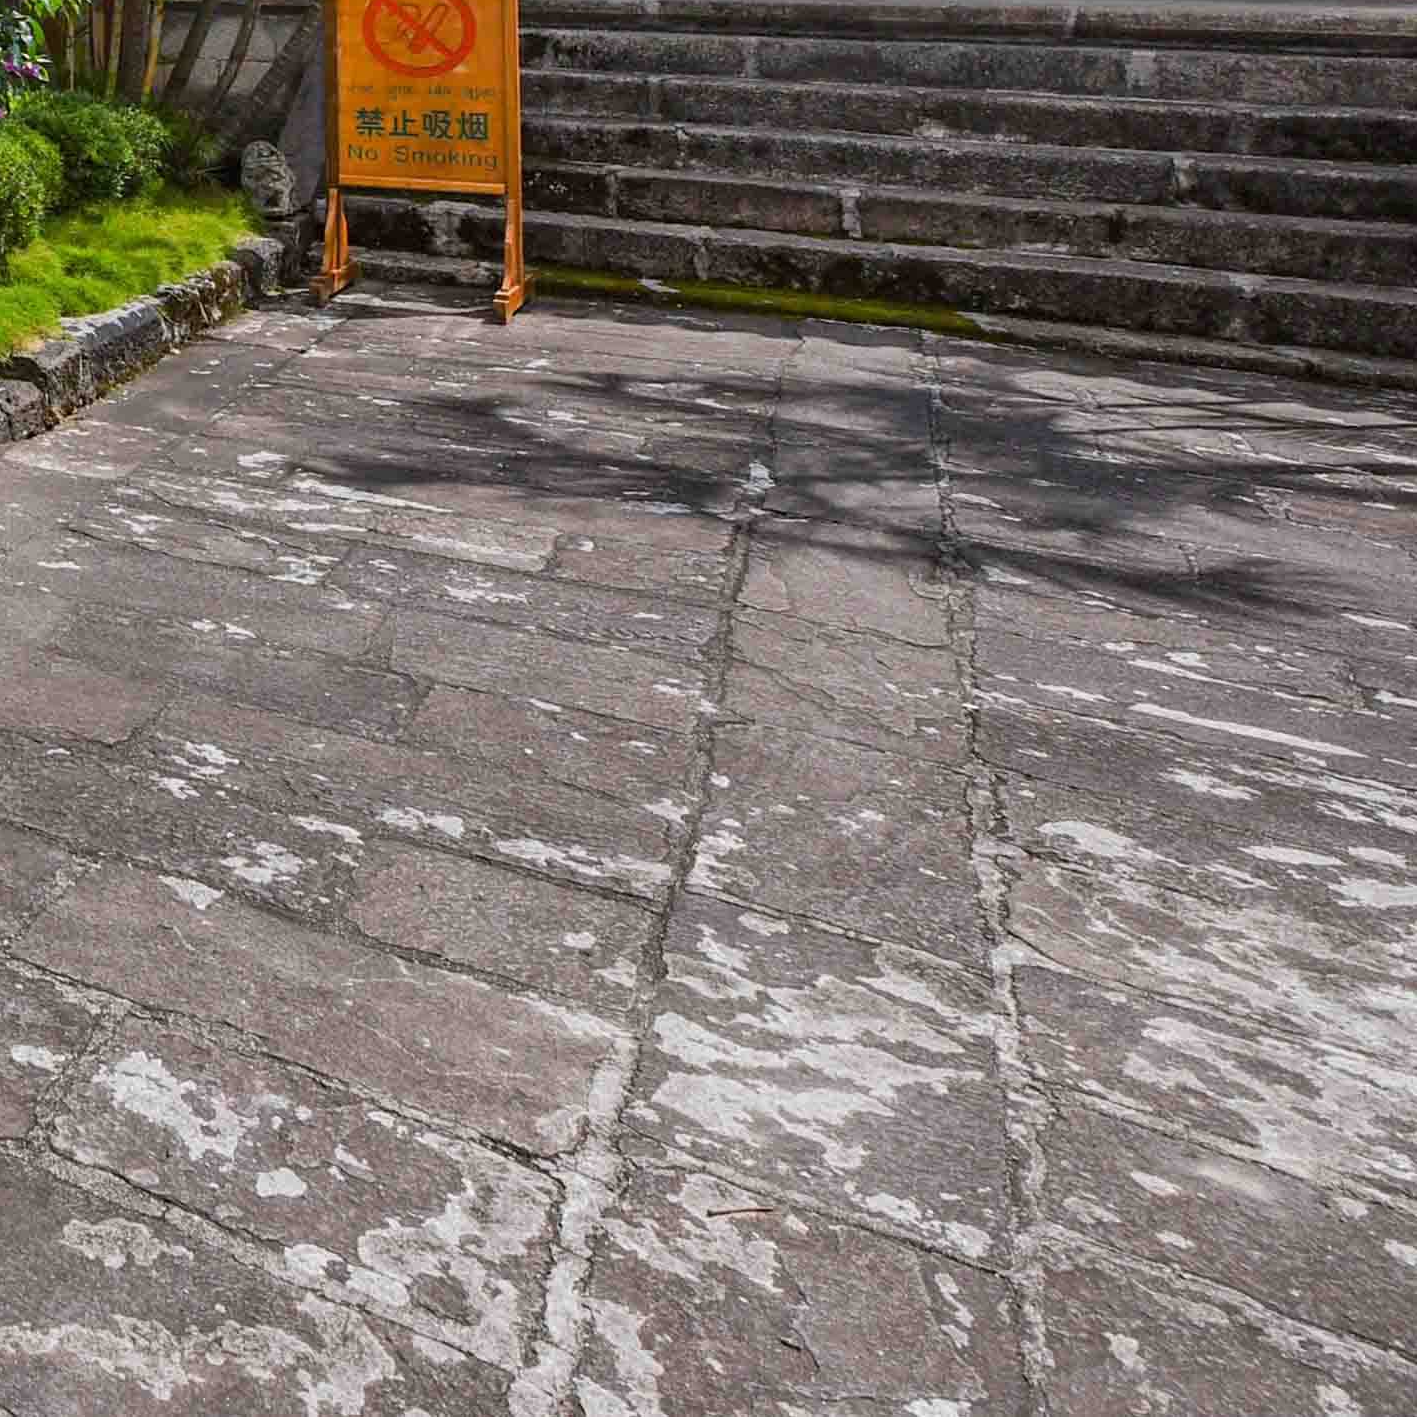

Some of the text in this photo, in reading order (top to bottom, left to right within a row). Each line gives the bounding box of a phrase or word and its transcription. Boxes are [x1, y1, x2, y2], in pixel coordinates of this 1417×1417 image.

[355, 106, 489, 141] 禁止吸烟
[348, 144, 499, 172] No Smoking
